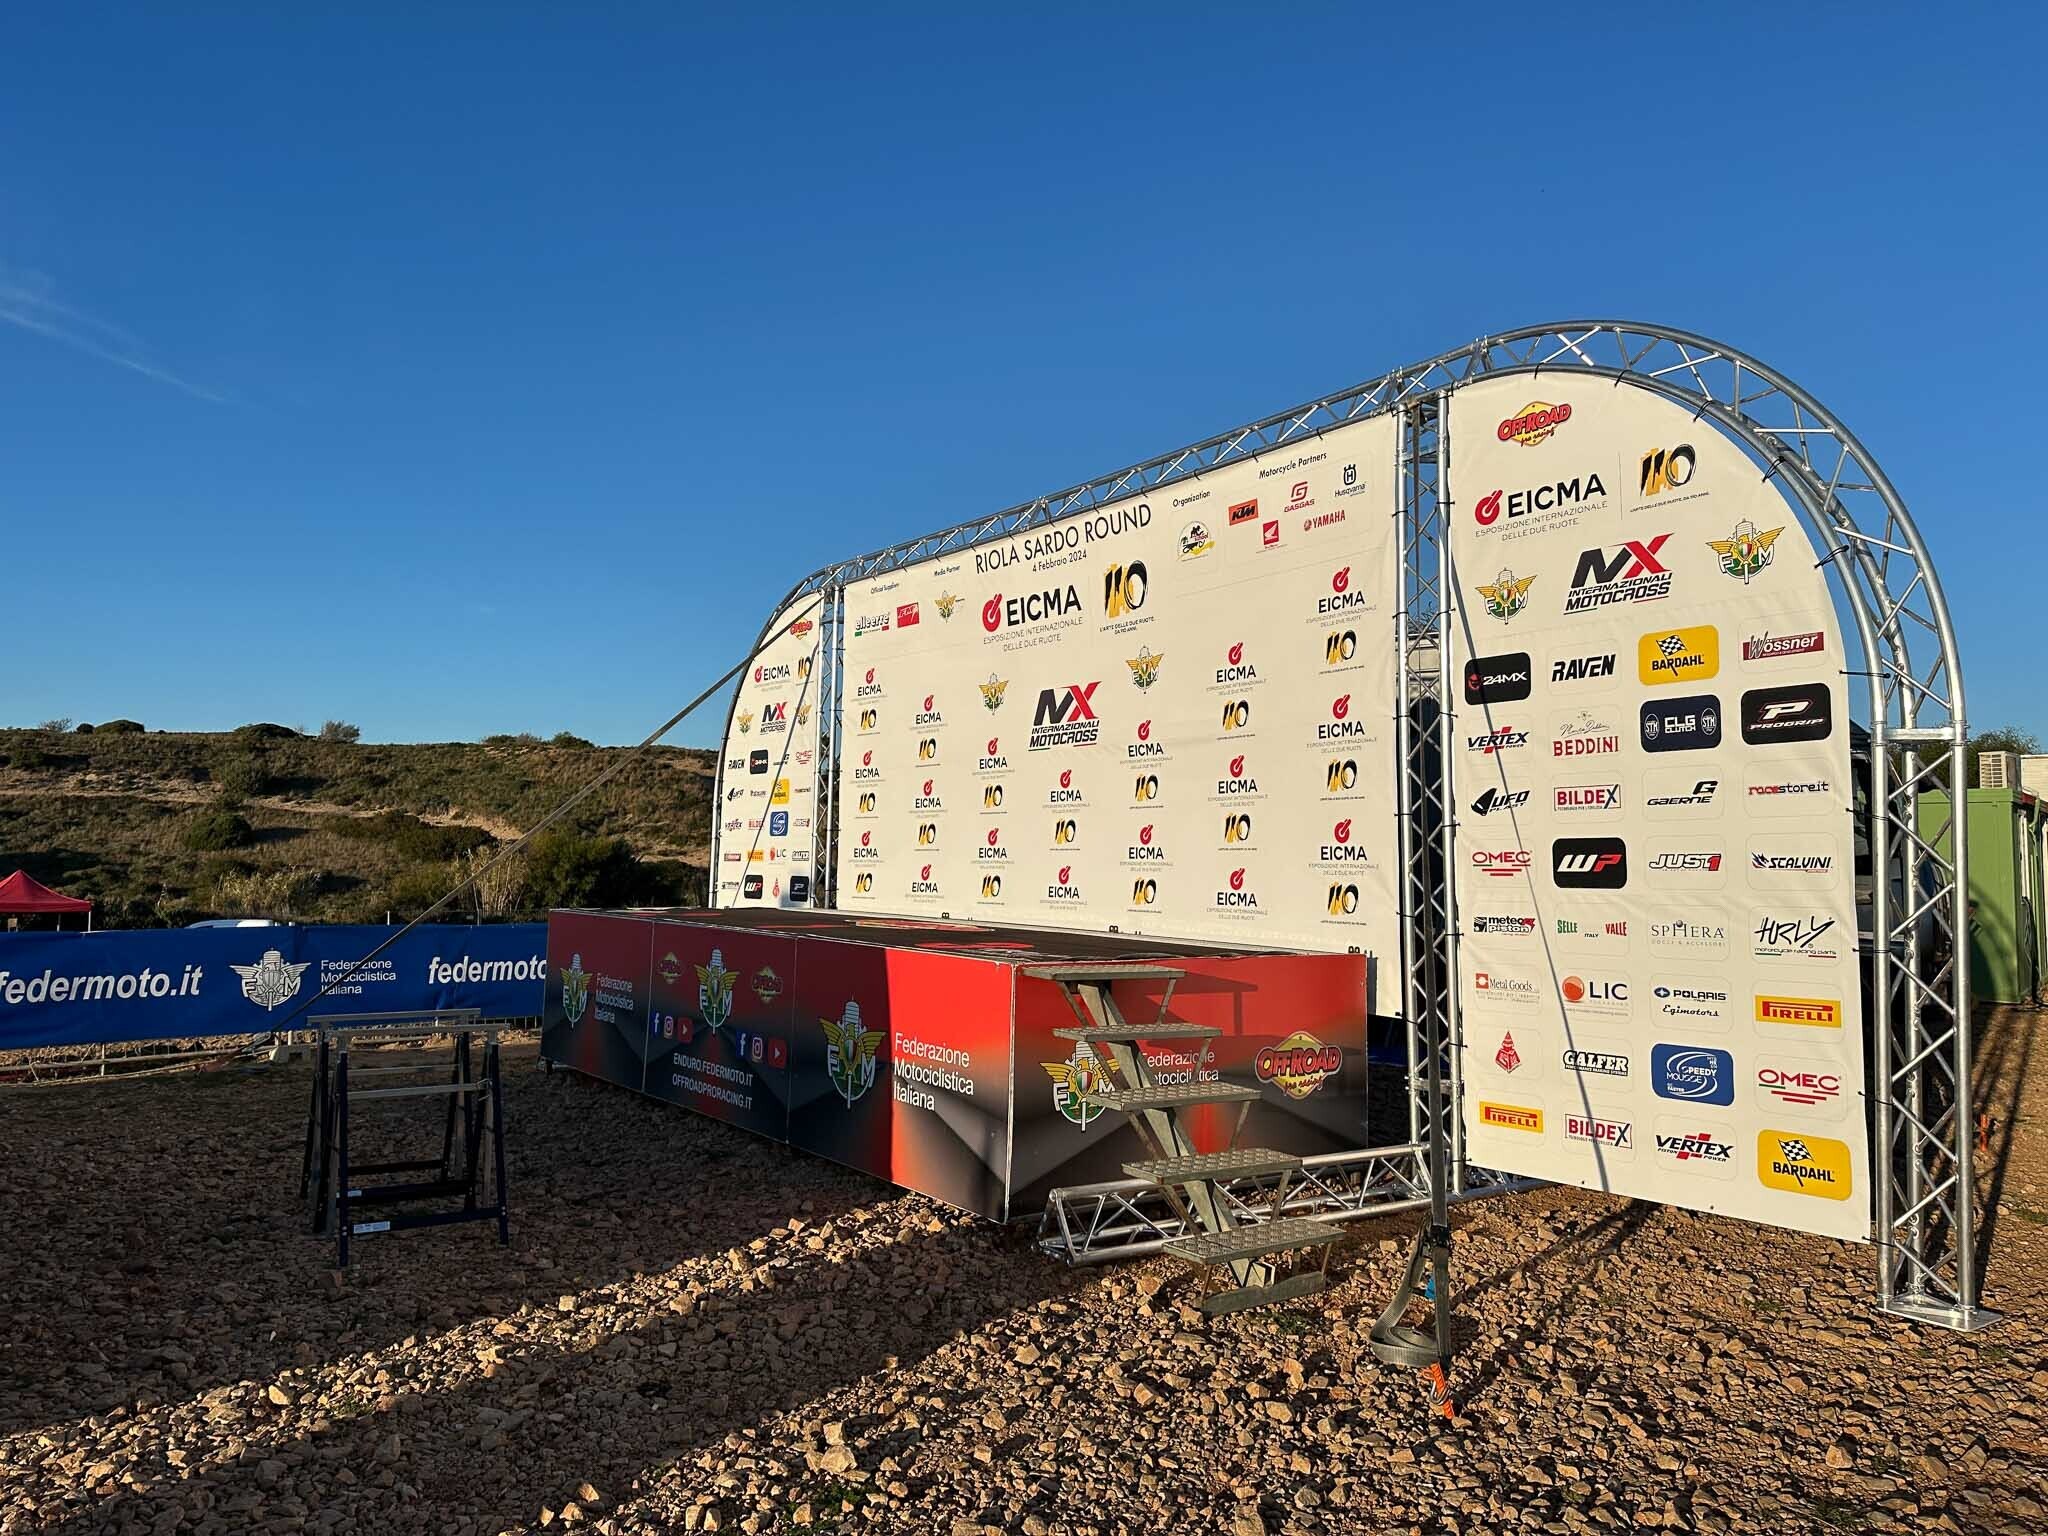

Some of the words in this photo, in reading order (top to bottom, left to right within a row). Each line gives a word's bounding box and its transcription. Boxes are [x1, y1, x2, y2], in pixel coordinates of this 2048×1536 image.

[1259, 462, 1296, 480] Motorcycle
[1298, 452, 1327, 468] Partners
[1172, 490, 1210, 508] Organization
[1508, 473, 1607, 518] EICMA
[1232, 504, 1256, 521] KTM
[1284, 499, 1315, 512] GASGAS
[1312, 510, 1346, 528] YAMAHA
[1475, 518, 1530, 538] ESPOSIZIONE
[1532, 501, 1608, 525] INTERNAZIONALE
[976, 545, 1020, 574] RIOLA
[1024, 525, 1080, 560] SARDO
[1084, 503, 1152, 544] ROUND
[1502, 528, 1528, 541] DELLE
[1529, 524, 1548, 536] DUE
[1549, 518, 1579, 530] RUOTE
[1032, 565, 1037, 573] 4
[1038, 556, 1067, 571] Febbraio
[1068, 550, 1087, 562] 2024
[1570, 532, 1675, 588] MX
[1568, 572, 1672, 598] INTERNAZIONALI
[1006, 584, 1082, 626] EICMA
[1318, 590, 1365, 613] EICMA
[1566, 582, 1671, 612] MOTOCROSS
[984, 629, 1024, 645] ESPOSIZIONE
[1026, 617, 1084, 636] INTERNAZIONALE
[1003, 641, 1023, 652] DELLE
[1024, 638, 1038, 648] DUE
[1039, 633, 1062, 646] RUOTE
[1749, 630, 1818, 659] Wössner
[1552, 654, 1616, 682] RAVEN
[1652, 655, 1704, 671] BARDAHL
[764, 664, 790, 681] EICMA
[1216, 665, 1256, 683] EICMA
[1483, 671, 1527, 686] 24MX
[857, 684, 882, 696] EICMA
[1034, 682, 1102, 726] MX
[915, 714, 942, 725] EICMA
[1032, 720, 1100, 734] INTERNAZIONALI
[1645, 721, 1658, 732] STM
[1664, 714, 1696, 726] CLG
[1703, 716, 1716, 728] STM
[1750, 718, 1824, 730] PROGRIP
[1030, 729, 1098, 748] MOTOCROSS
[1318, 720, 1365, 739] EICMA
[1665, 726, 1696, 734] CLUTCH
[1468, 732, 1530, 748] VERTEX
[1553, 736, 1619, 756] BEDDINI
[1128, 742, 1164, 757] EICMA
[979, 757, 1008, 770] EICMA
[855, 768, 880, 779] EICMA
[1050, 790, 1082, 802] EICMA
[1218, 780, 1258, 794] EICMA
[915, 797, 942, 808] EICMA
[1492, 790, 1530, 809] UFO
[1557, 784, 1618, 809] BILDEX
[1647, 795, 1712, 806] GAERNE
[853, 848, 878, 858] EICMA
[978, 847, 1007, 858] EICMA
[1128, 847, 1164, 860] EICMA
[1320, 846, 1368, 860] EICMA
[1472, 852, 1531, 864] OMEC
[1557, 854, 1622, 872] WP
[1648, 854, 1721, 872] JUST1
[1768, 857, 1832, 868] SCALVINI
[912, 882, 938, 893] EICMA
[1048, 886, 1079, 899] EICMA
[1217, 892, 1257, 907] EICMA
[1489, 925, 1530, 933] piston
[1557, 920, 1578, 934] SELLE
[1605, 922, 1627, 936] VALLE
[1651, 918, 1724, 939] SPHERA
[321, 960, 392, 970] Federzione
[596, 972, 633, 992] Federazione
[1489, 978, 1508, 990] Metal
[1509, 981, 1533, 991] Goods
[1589, 982, 1628, 1000] LIC
[1674, 990, 1726, 1000] POLARIS
[1663, 1004, 1719, 1017] Egimotors
[1762, 1001, 1834, 1022] PIRELLI
[895, 1032, 970, 1068] Federazione
[673, 1052, 753, 1086] ENDURO.FEDERMOTO.IT
[1564, 1050, 1628, 1072] GALFER
[894, 1056, 974, 1095] Motociclistica
[1666, 1072, 1702, 1084] MOUSSE
[1681, 1066, 1717, 1077] SPEEDY
[1758, 1069, 1839, 1090] OMEC
[672, 1074, 752, 1110] OFFROADPRORACING.IT
[893, 1081, 935, 1111] Italiana
[1485, 1106, 1537, 1128] PIRELLI
[1568, 1118, 1630, 1146] BILDEX
[1656, 1135, 1734, 1158] VERTEX
[1773, 1162, 1835, 1182] BARDAHL
